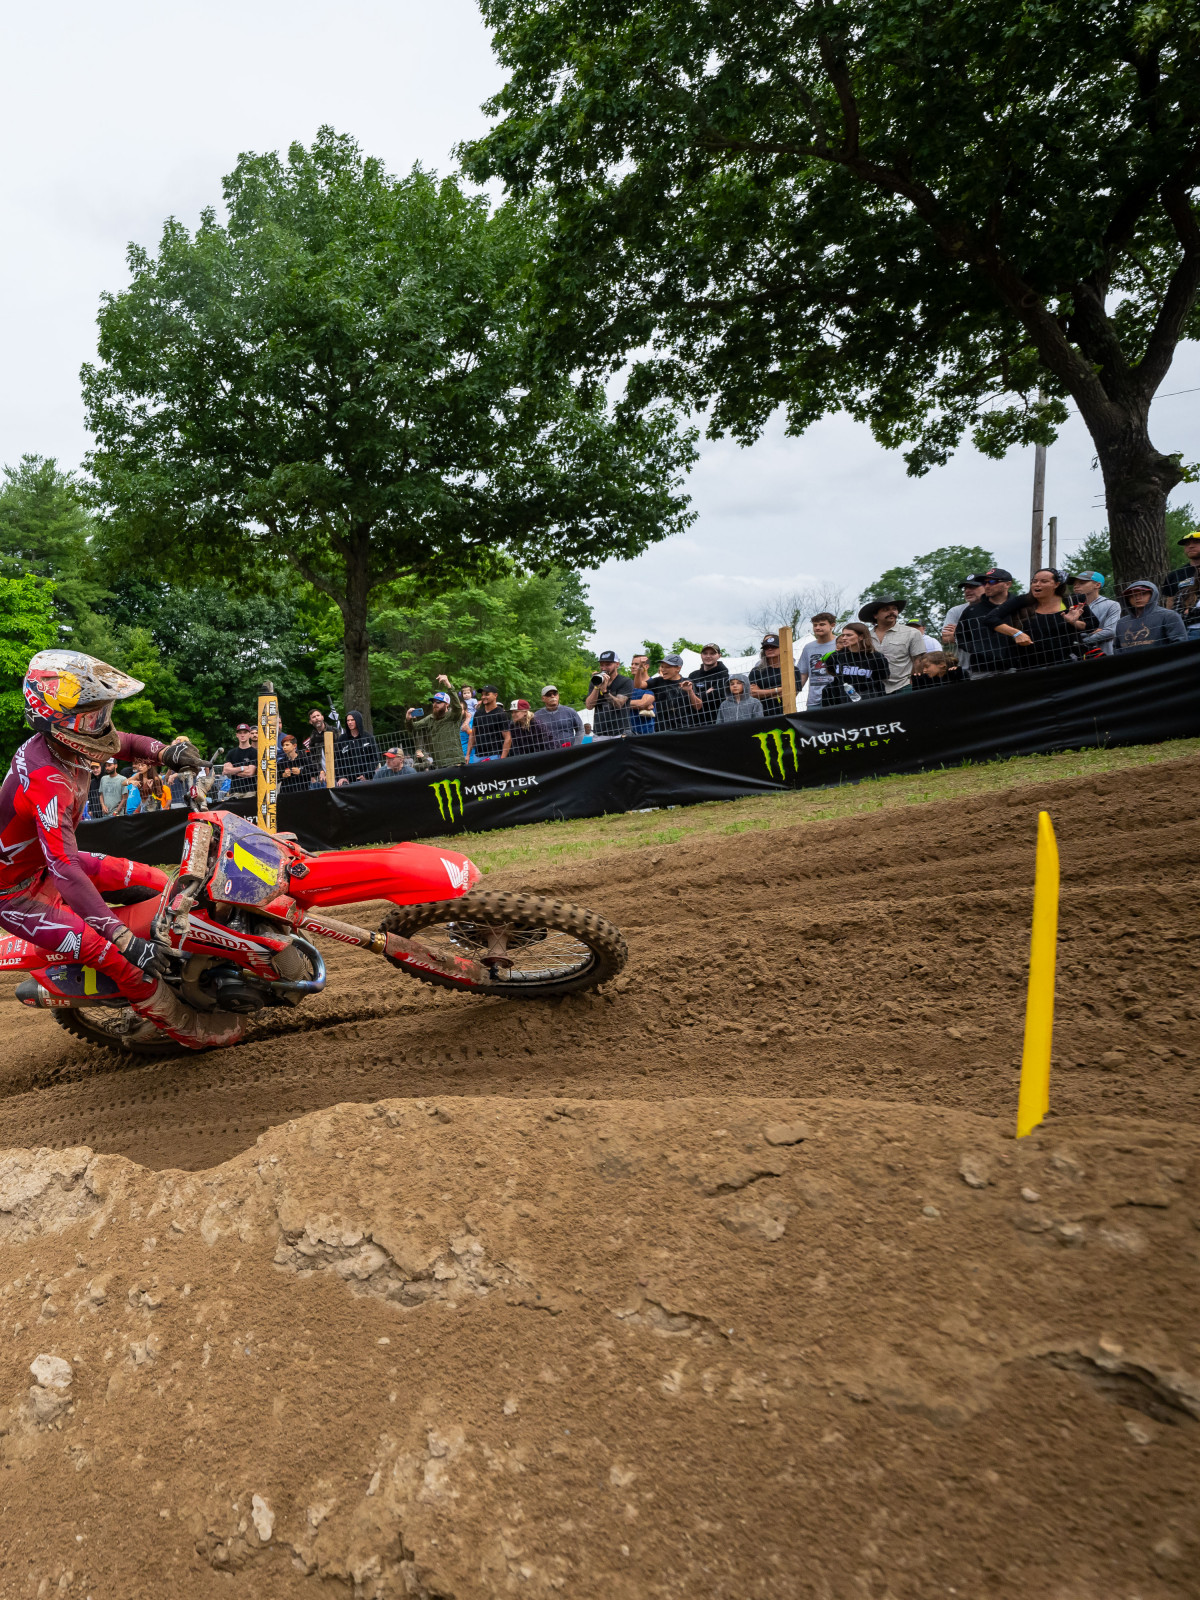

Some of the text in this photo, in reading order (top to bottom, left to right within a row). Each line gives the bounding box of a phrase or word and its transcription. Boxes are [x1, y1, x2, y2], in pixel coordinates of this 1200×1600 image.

[267, 714, 276, 740] WICK
[800, 721, 906, 749] MONSTER
[819, 738, 891, 755] ENERGY
[15, 738, 30, 793] RENCE
[267, 759, 276, 784] WICK
[464, 775, 539, 796] MONSTER
[478, 789, 528, 801] ENERGY
[268, 803, 276, 829] WICK
[234, 842, 278, 886] 1
[188, 929, 255, 952] HONDA
[81, 964, 99, 996] 1
